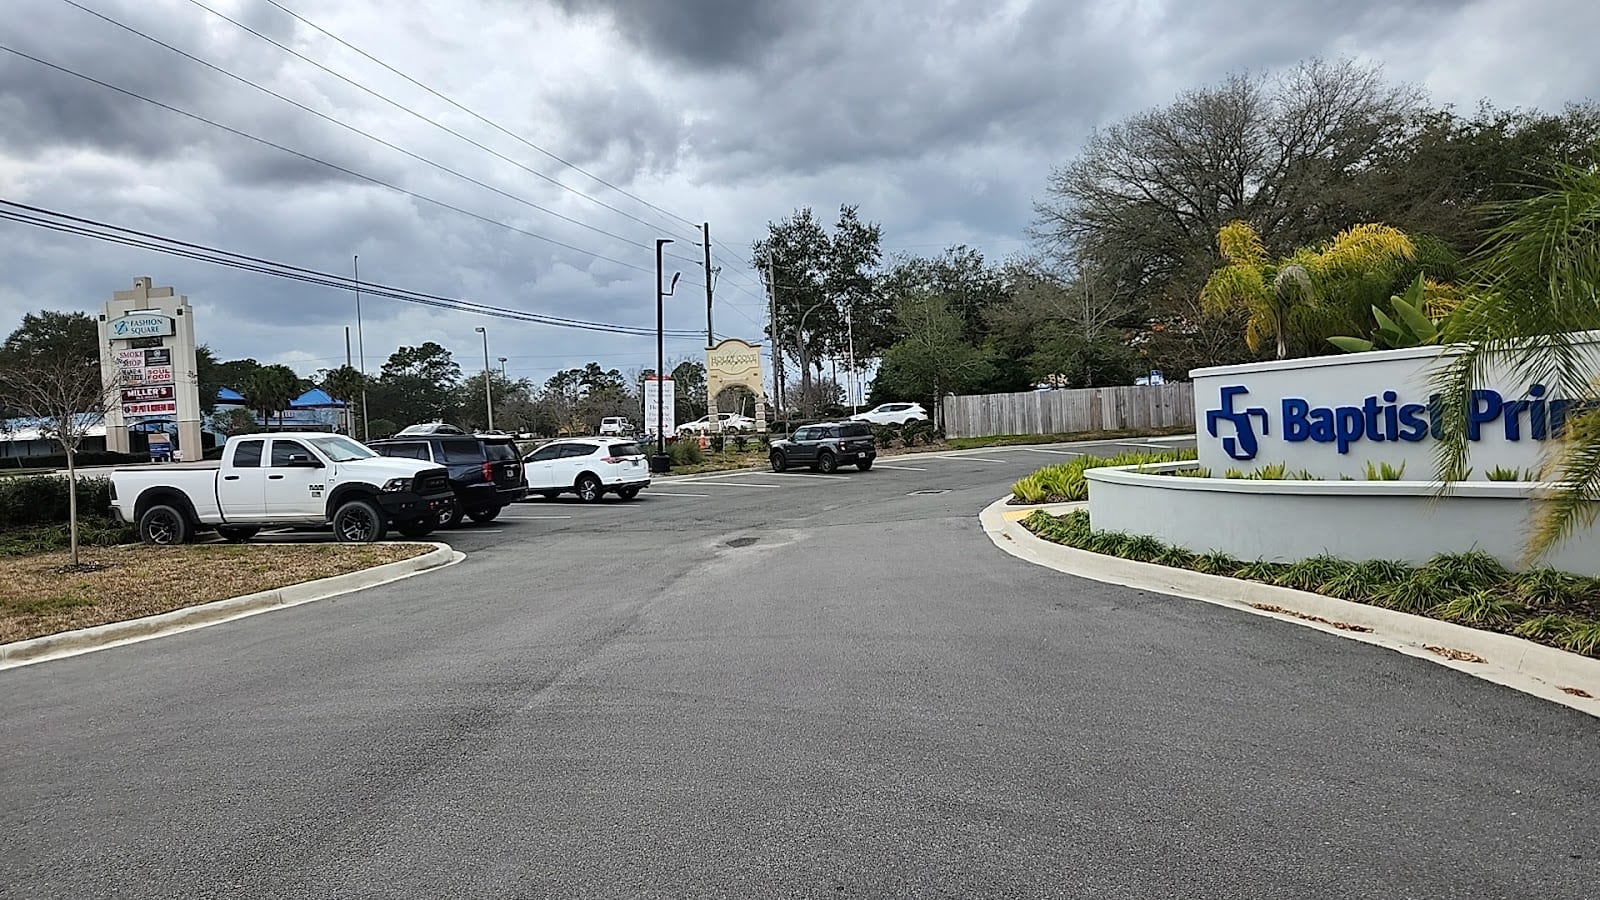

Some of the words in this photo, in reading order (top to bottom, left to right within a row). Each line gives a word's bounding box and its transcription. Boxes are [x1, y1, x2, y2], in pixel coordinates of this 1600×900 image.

[130, 318, 163, 327] FASHION
[130, 326, 160, 335] SQUARE
[127, 387, 167, 397] MILLER'S
[1281, 390, 1450, 455] Baptist
